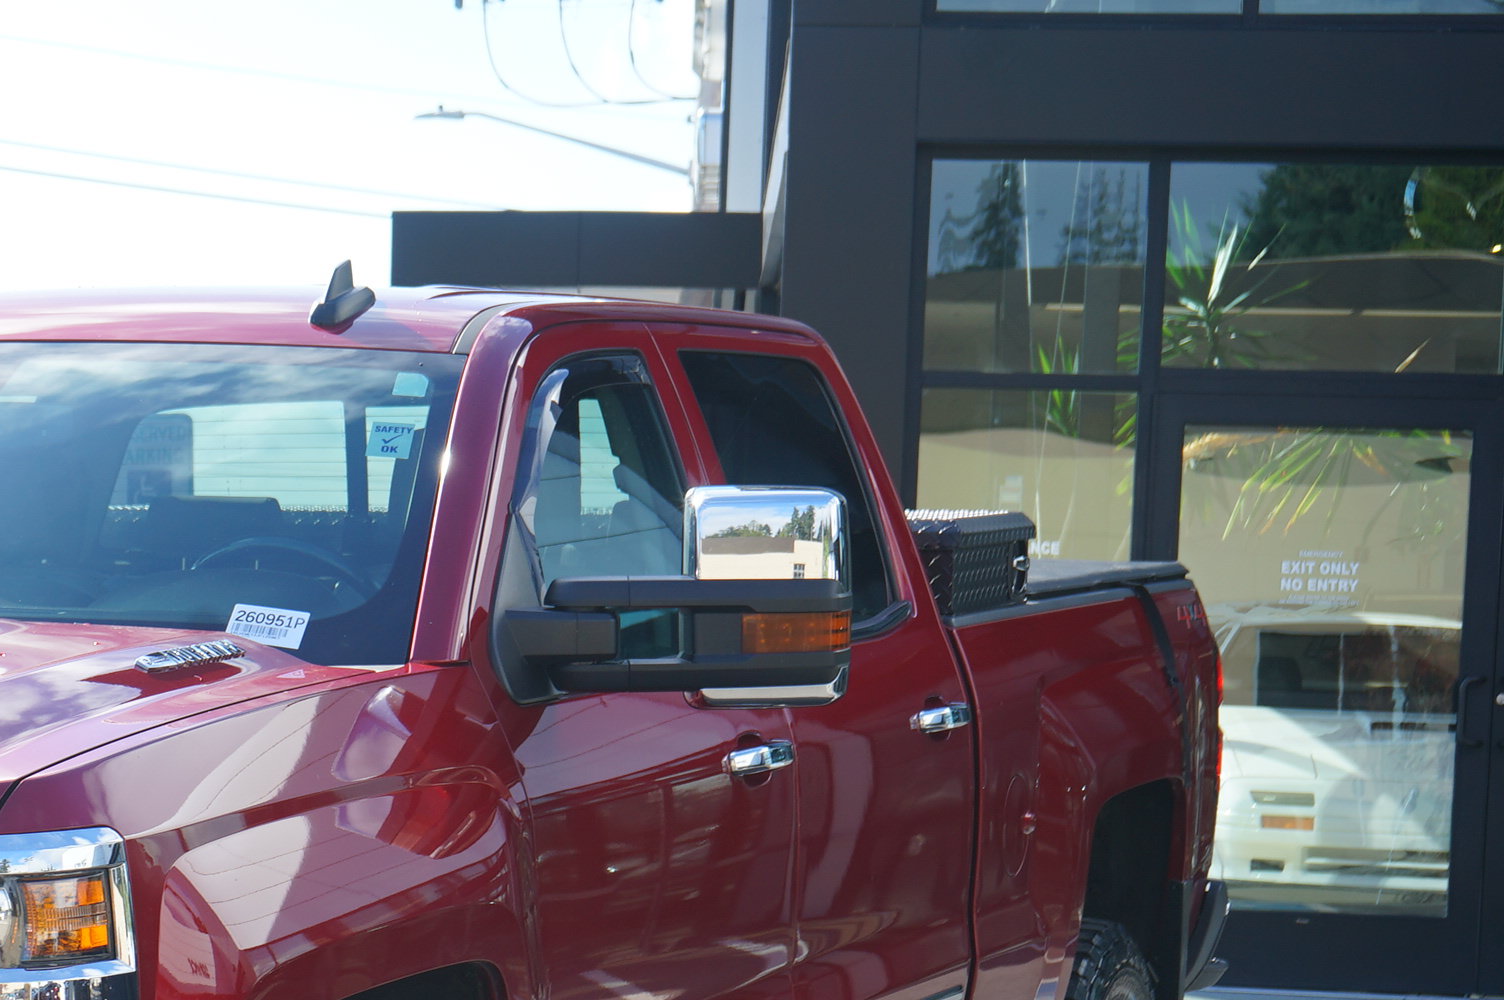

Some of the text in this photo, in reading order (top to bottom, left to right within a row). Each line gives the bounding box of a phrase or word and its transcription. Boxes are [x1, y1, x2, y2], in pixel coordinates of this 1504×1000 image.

[375, 425, 414, 435] SAFETY
[380, 445, 398, 454] OK
[1281, 560, 1360, 576] EXIT ONLY
[1280, 577, 1359, 593] NO ENTRY
[235, 609, 305, 630] 260951P
